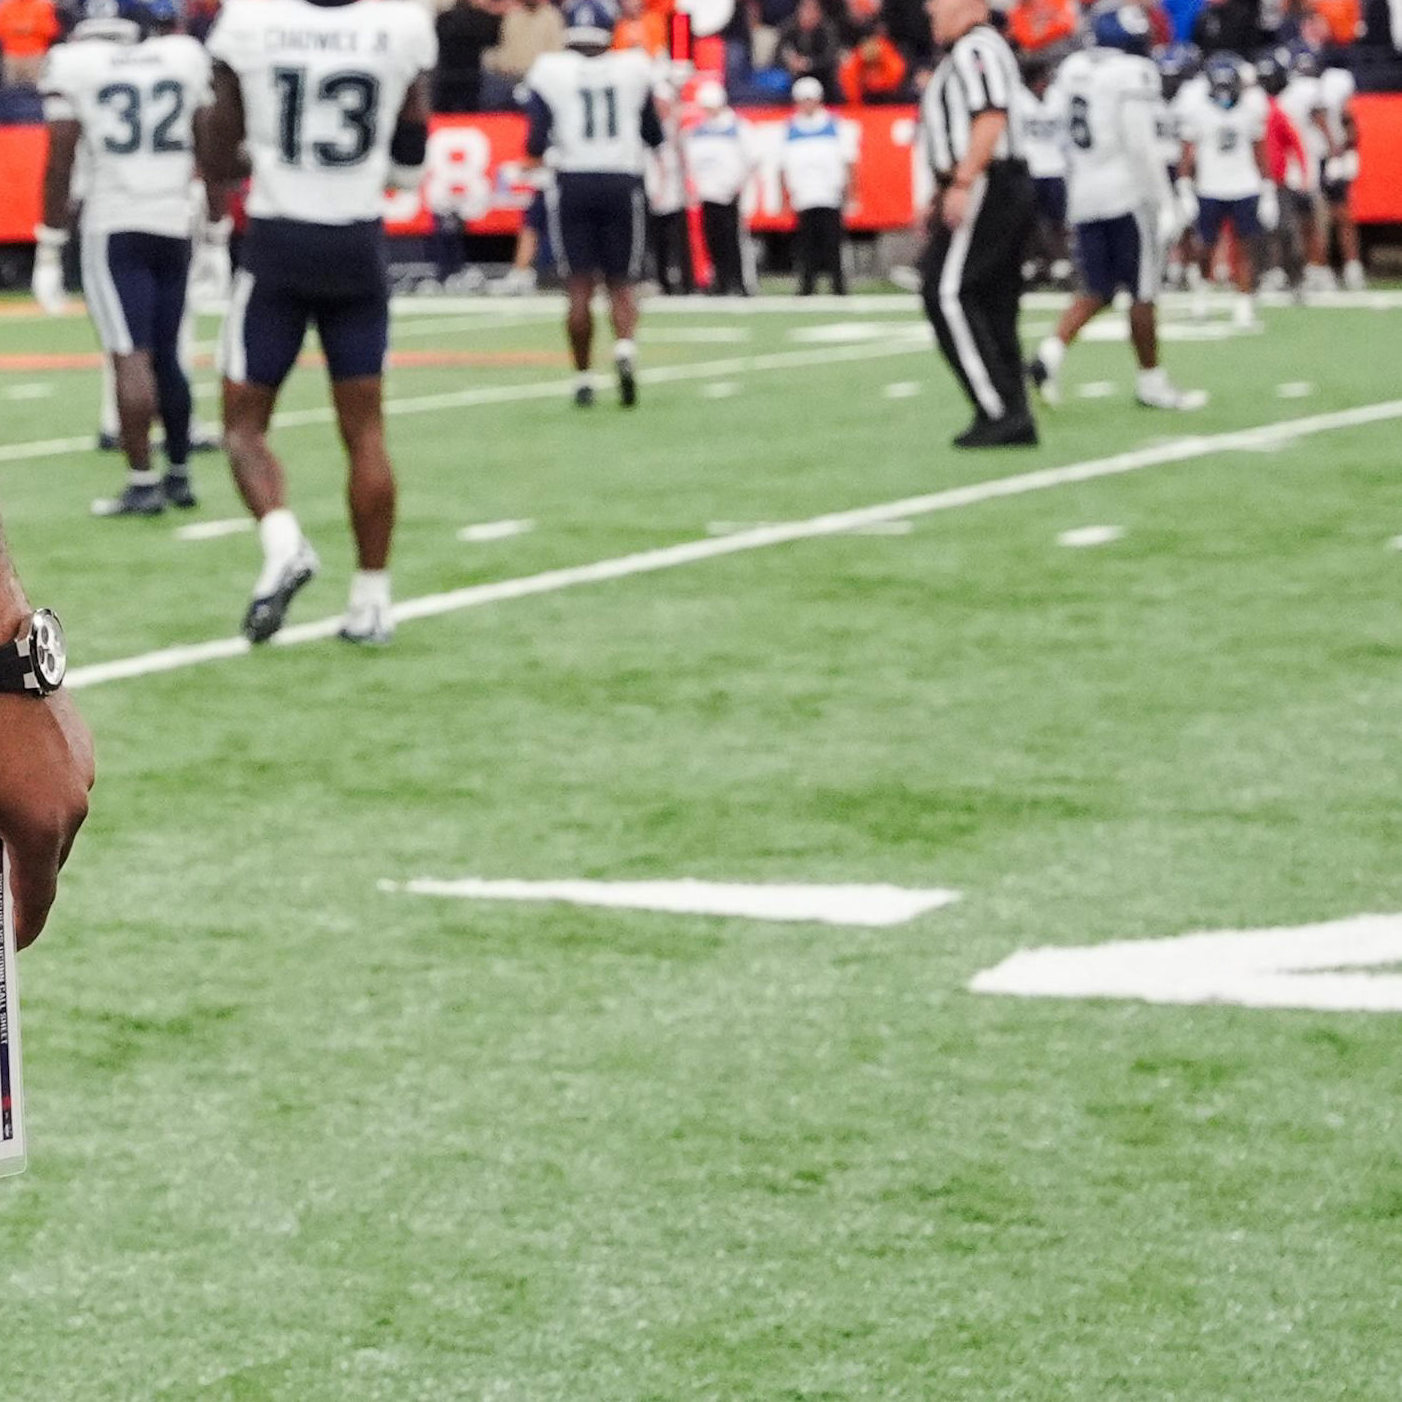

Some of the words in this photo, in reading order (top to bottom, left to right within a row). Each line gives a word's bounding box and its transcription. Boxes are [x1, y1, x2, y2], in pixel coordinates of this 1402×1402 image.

[98, 80, 184, 154] 32
[273, 65, 380, 168] 13
[580, 87, 616, 139] 11
[0, 985, 7, 1010] CALL
[0, 1014, 8, 1045] SHEET
